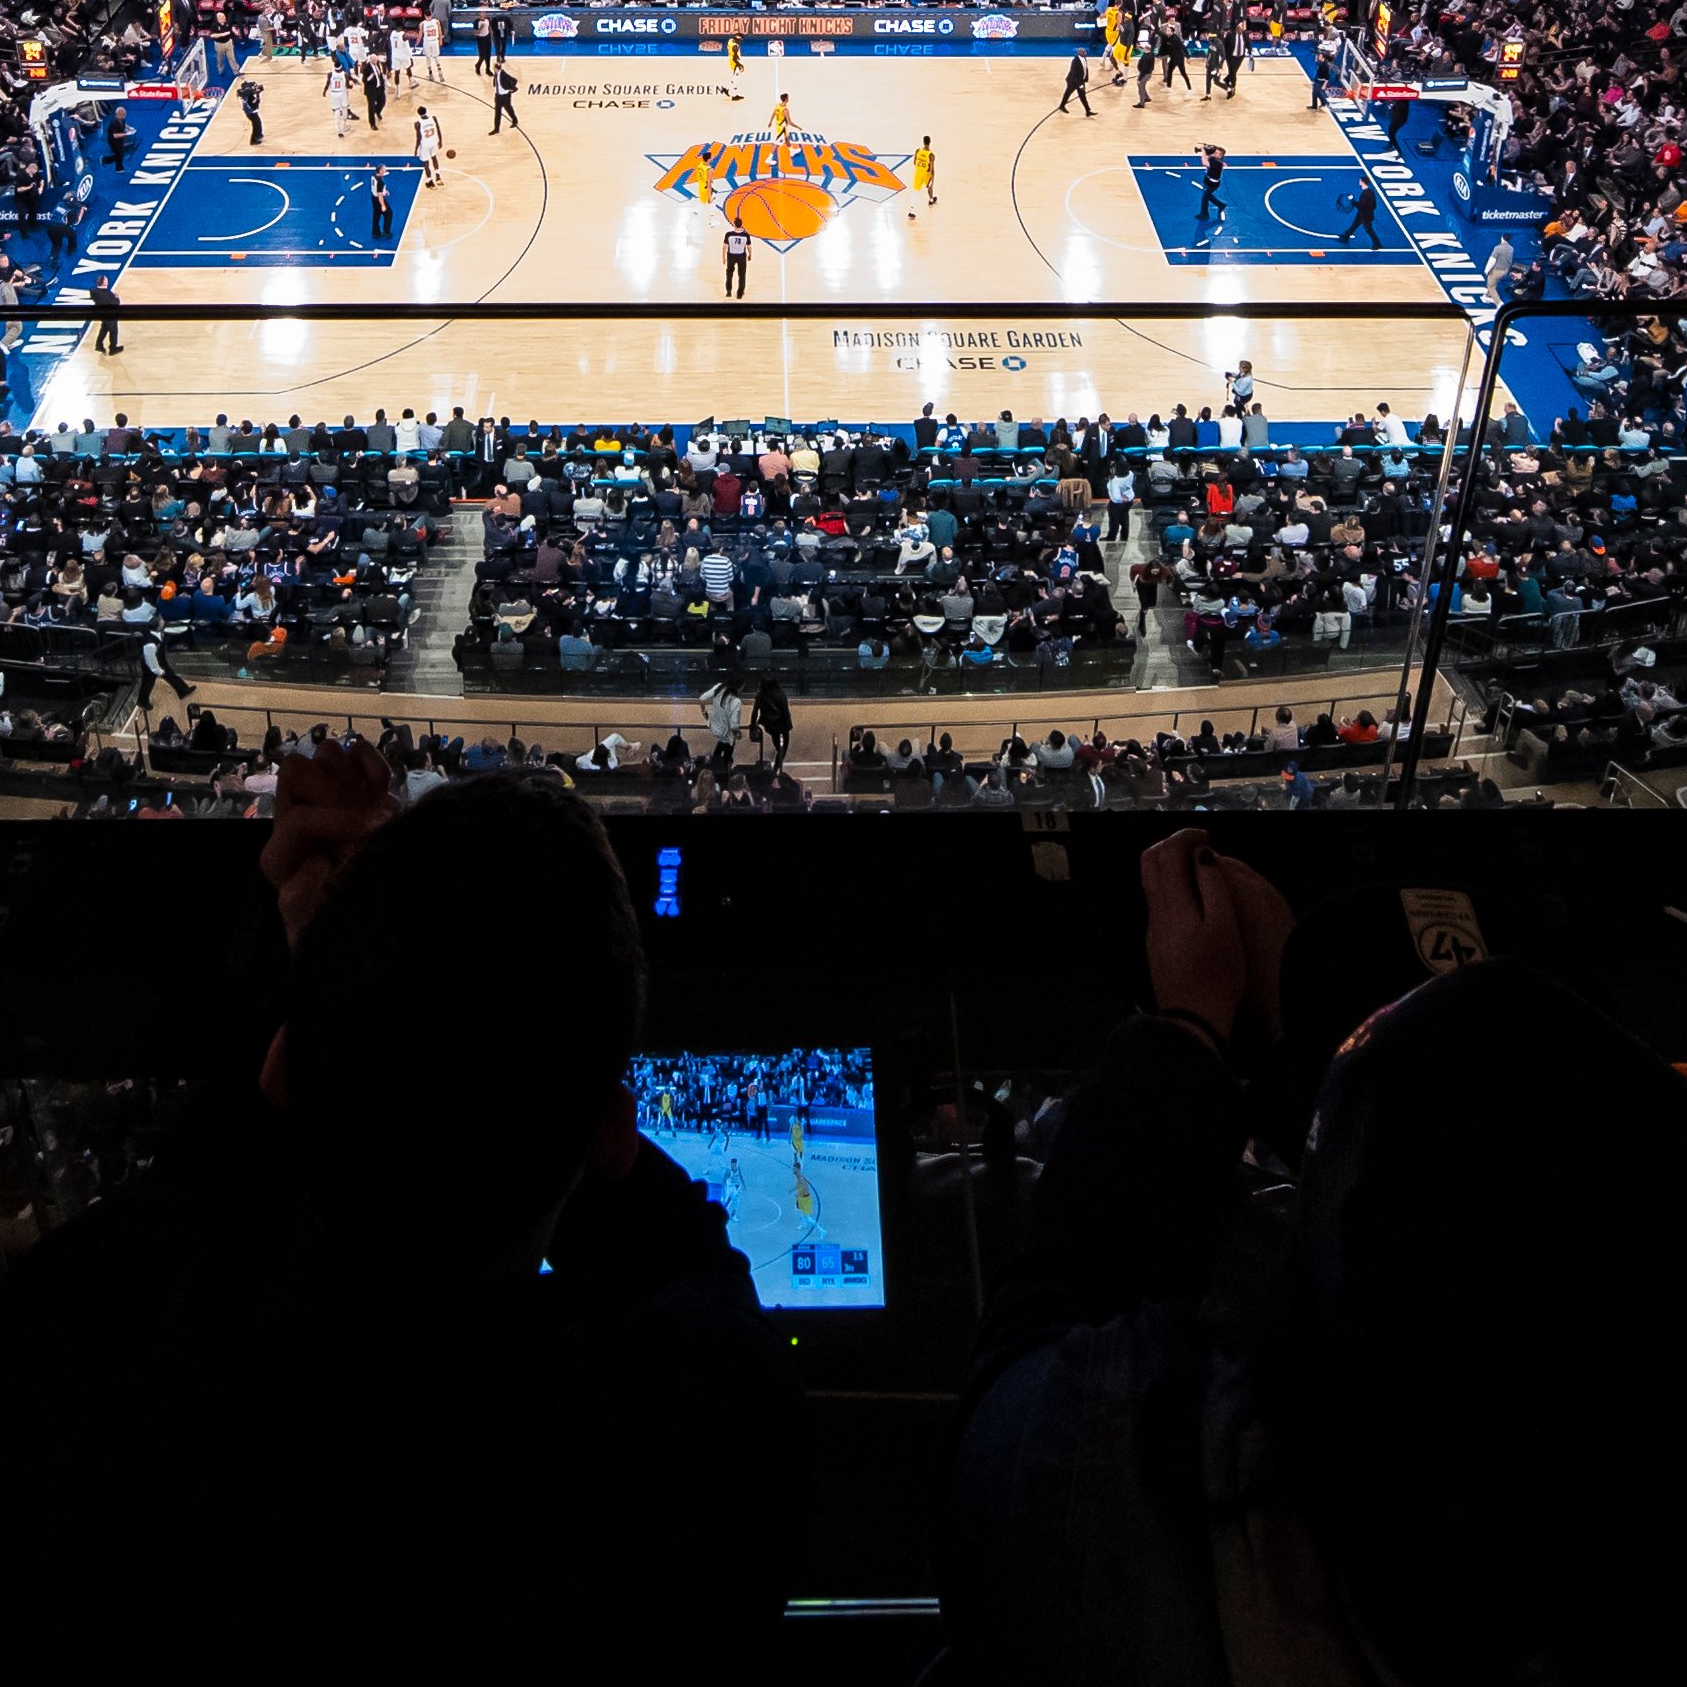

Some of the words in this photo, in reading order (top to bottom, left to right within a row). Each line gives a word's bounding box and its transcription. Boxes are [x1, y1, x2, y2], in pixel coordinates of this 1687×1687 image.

[596, 18, 659, 33] CHASE
[698, 17, 750, 35] FRIDAY
[752, 17, 796, 35] NIGHT
[798, 17, 854, 35] KNICKS
[874, 19, 936, 33] CHASE
[528, 83, 597, 95] MADISON
[602, 83, 660, 96] SQUARE
[573, 100, 650, 109] CHASE
[731, 132, 772, 144] NEW
[778, 131, 828, 144] ORK
[654, 141, 907, 194] KNICKS
[1362, 150, 1441, 216] YORK
[1482, 209, 1544, 220] ticketmaster
[72, 200, 160, 276] YORK
[1007, 330, 1083, 348] GARDEN
[1034, 812, 1056, 829] 18
[797, 1257, 811, 1270] 80
[821, 1257, 835, 1269] 65
